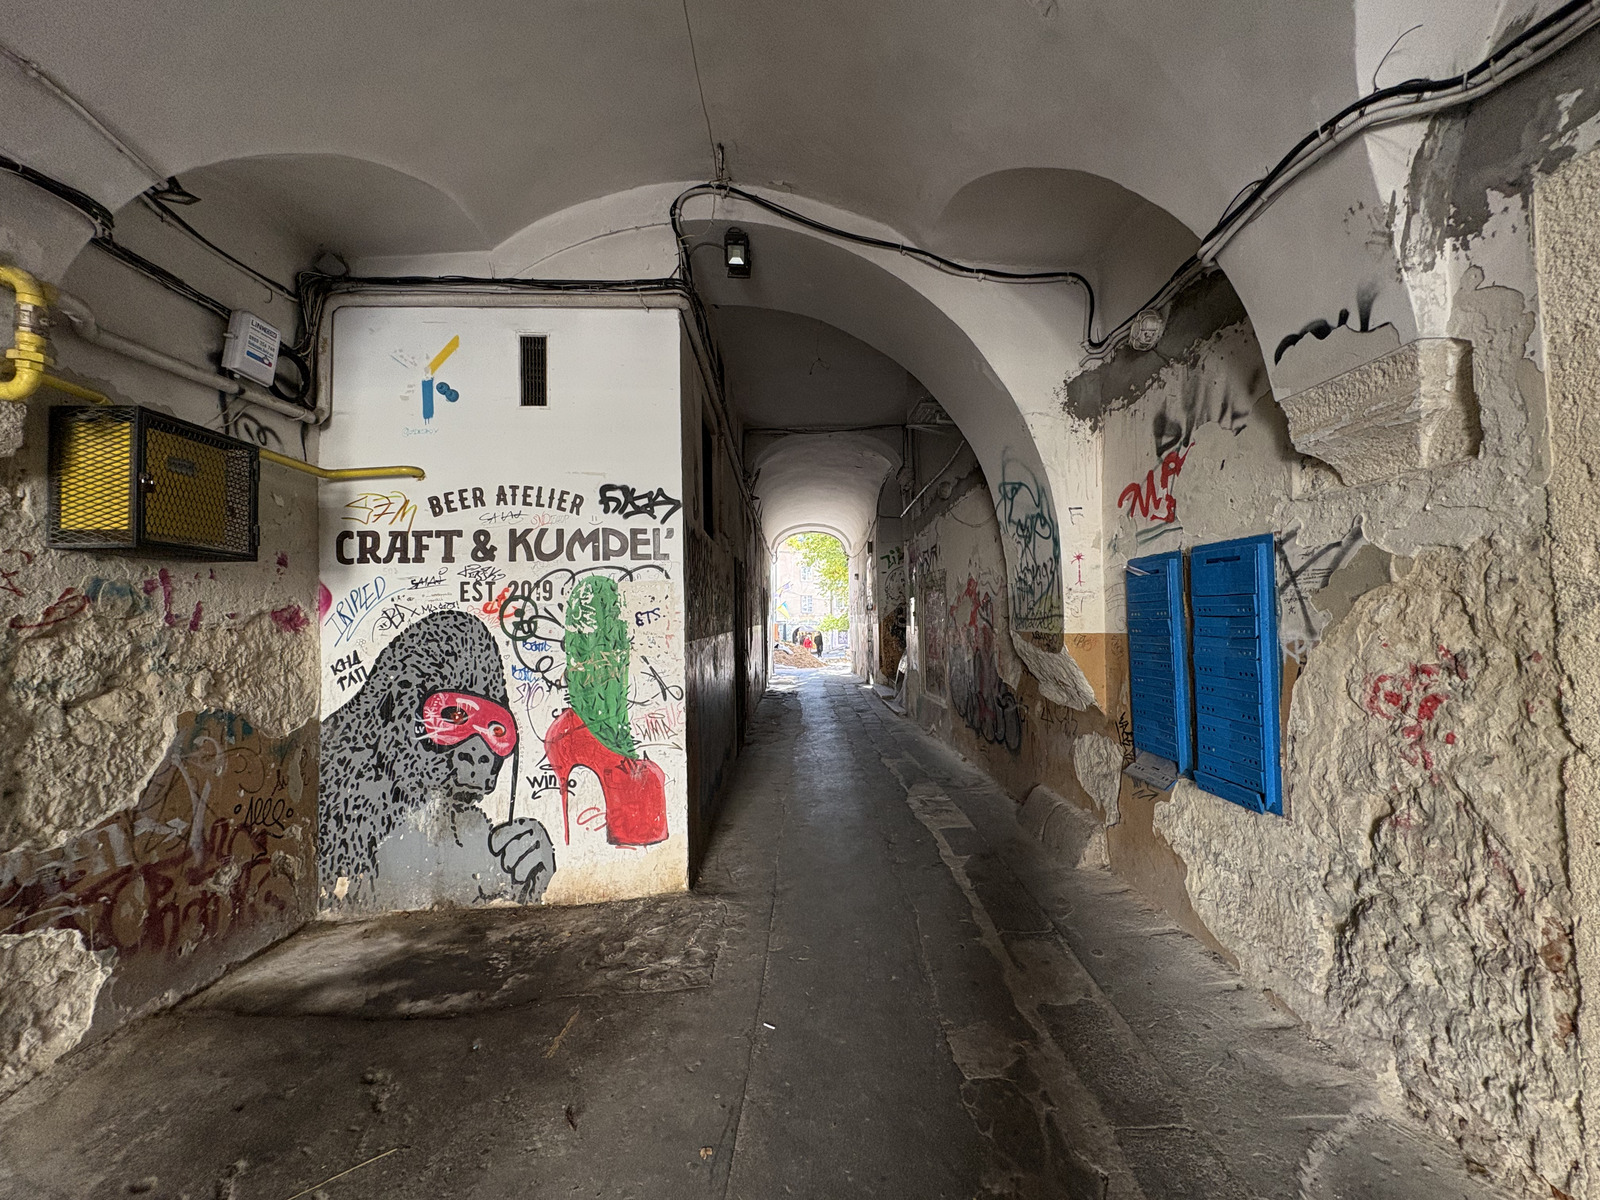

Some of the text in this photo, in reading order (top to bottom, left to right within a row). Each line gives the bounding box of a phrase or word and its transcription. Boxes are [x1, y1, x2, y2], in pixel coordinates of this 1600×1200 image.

[427, 486, 487, 518] BEER
[495, 485, 585, 516] ATELIER
[335, 529, 464, 565] CRAFT
[470, 529, 498, 562] &
